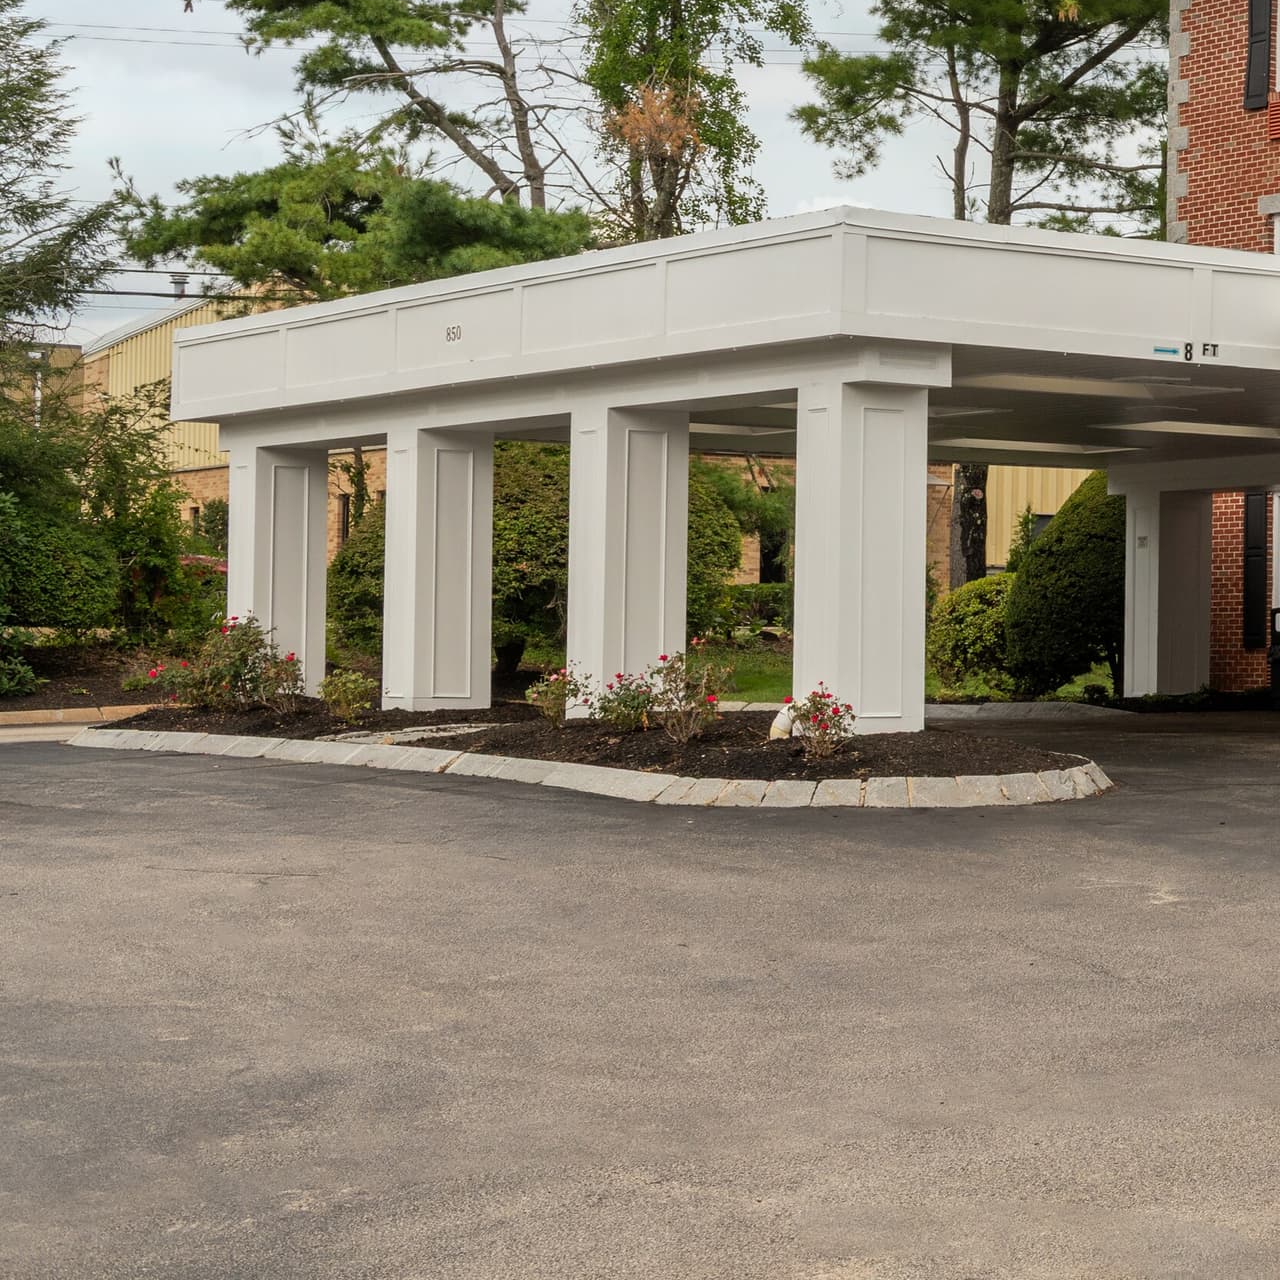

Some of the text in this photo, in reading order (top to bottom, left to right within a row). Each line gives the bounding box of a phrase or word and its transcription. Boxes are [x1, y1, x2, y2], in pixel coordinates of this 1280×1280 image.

[446, 325, 462, 342] 850
[1184, 342, 1219, 361] 8 FT
